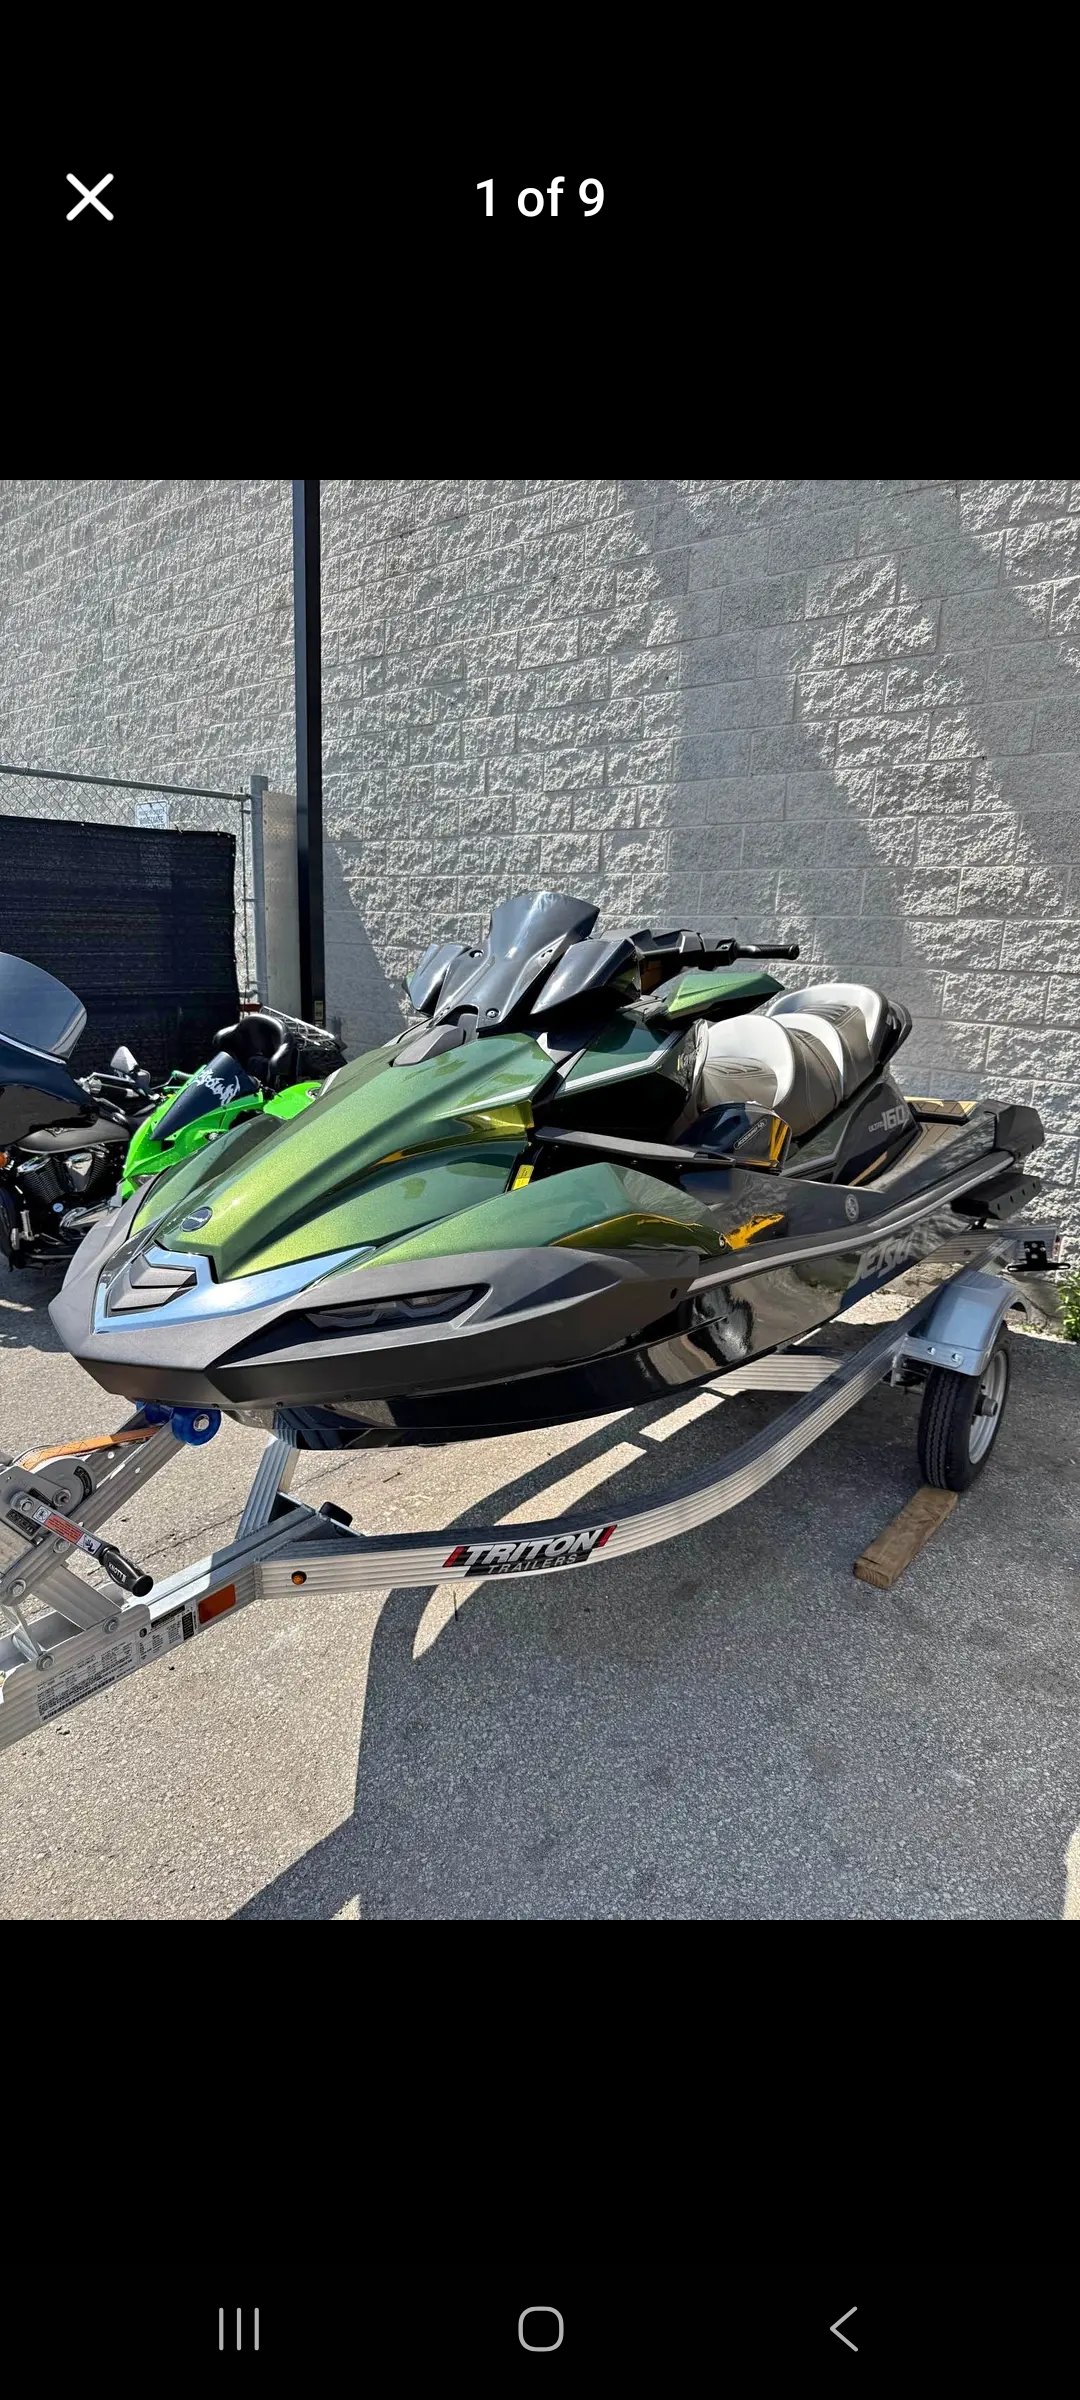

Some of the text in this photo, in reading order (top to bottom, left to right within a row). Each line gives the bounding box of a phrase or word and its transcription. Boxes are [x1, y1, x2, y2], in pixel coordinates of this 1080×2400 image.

[464, 1528, 604, 1566] TRITON
[108, 1562, 124, 1579] KNOTT
[487, 1553, 579, 1575] TRAILERS
